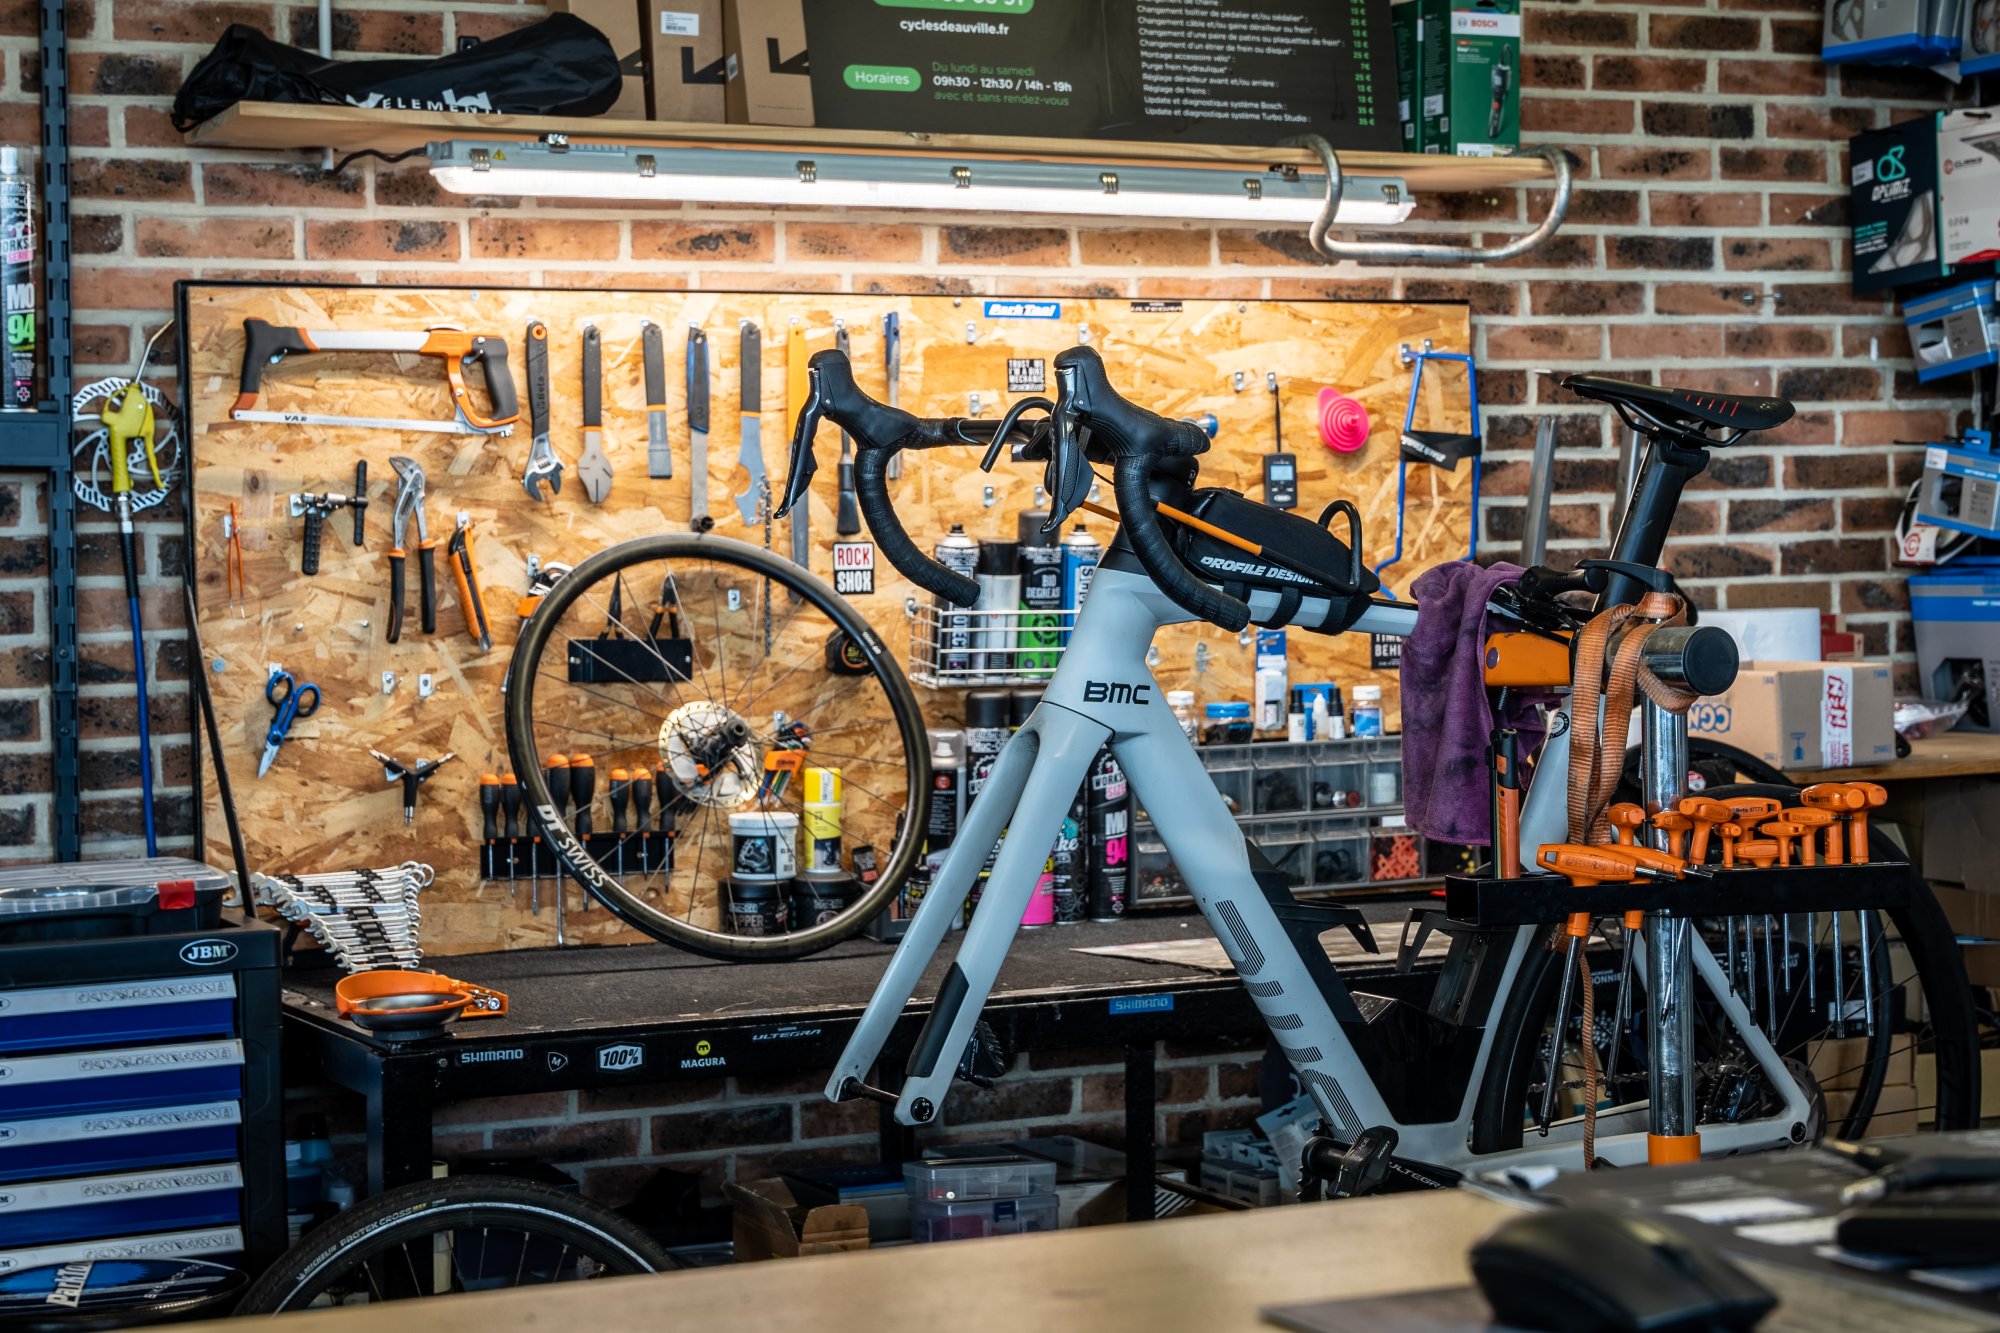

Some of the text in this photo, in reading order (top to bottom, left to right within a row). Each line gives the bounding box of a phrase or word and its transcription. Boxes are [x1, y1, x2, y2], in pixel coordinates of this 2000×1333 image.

[900, 18, 1010, 36] cyclesdeauville.fr
[1471, 19, 1499, 28] BOSCH
[1140, 50, 1173, 60] Montage
[932, 61, 1035, 77] Du lundi au samedi
[1141, 61, 1163, 71] Purge
[854, 71, 910, 86] Horaires
[932, 75, 971, 87] 09h30
[980, 77, 1014, 90] 12h30
[1024, 79, 1044, 91] 14h
[1053, 81, 1073, 92] 19h
[1174, 86, 1184, 94] de
[934, 91, 1070, 106] avec et sans rendez-vous
[1143, 96, 1171, 106] Update
[1173, 97, 1181, 105] et
[1260, 101, 1283, 110] Bosch
[1144, 107, 1172, 117] Update
[1173, 108, 1182, 116] et
[8, 313, 35, 345] 94
[837, 547, 870, 566] ROCK
[1200, 555, 1267, 576] PROFILE
[836, 570, 872, 593] SHOX
[1374, 643, 1401, 657] BEHI
[1083, 680, 1151, 705] BMC
[1105, 810, 1128, 836] MO
[537, 804, 609, 888] DT SWISS
[1106, 837, 1128, 866] 94
[187, 944, 229, 960] JBM
[1115, 997, 1168, 1010] SHIMANO
[752, 1029, 821, 1041] ULTEGRA
[461, 1048, 523, 1064] SHIMANO
[602, 1049, 639, 1067] 100%
[680, 1056, 727, 1069] MAGURA
[303, 1243, 337, 1273] MICHELIN
[339, 1221, 379, 1247] PROTEK
[379, 1206, 412, 1227] CROSS
